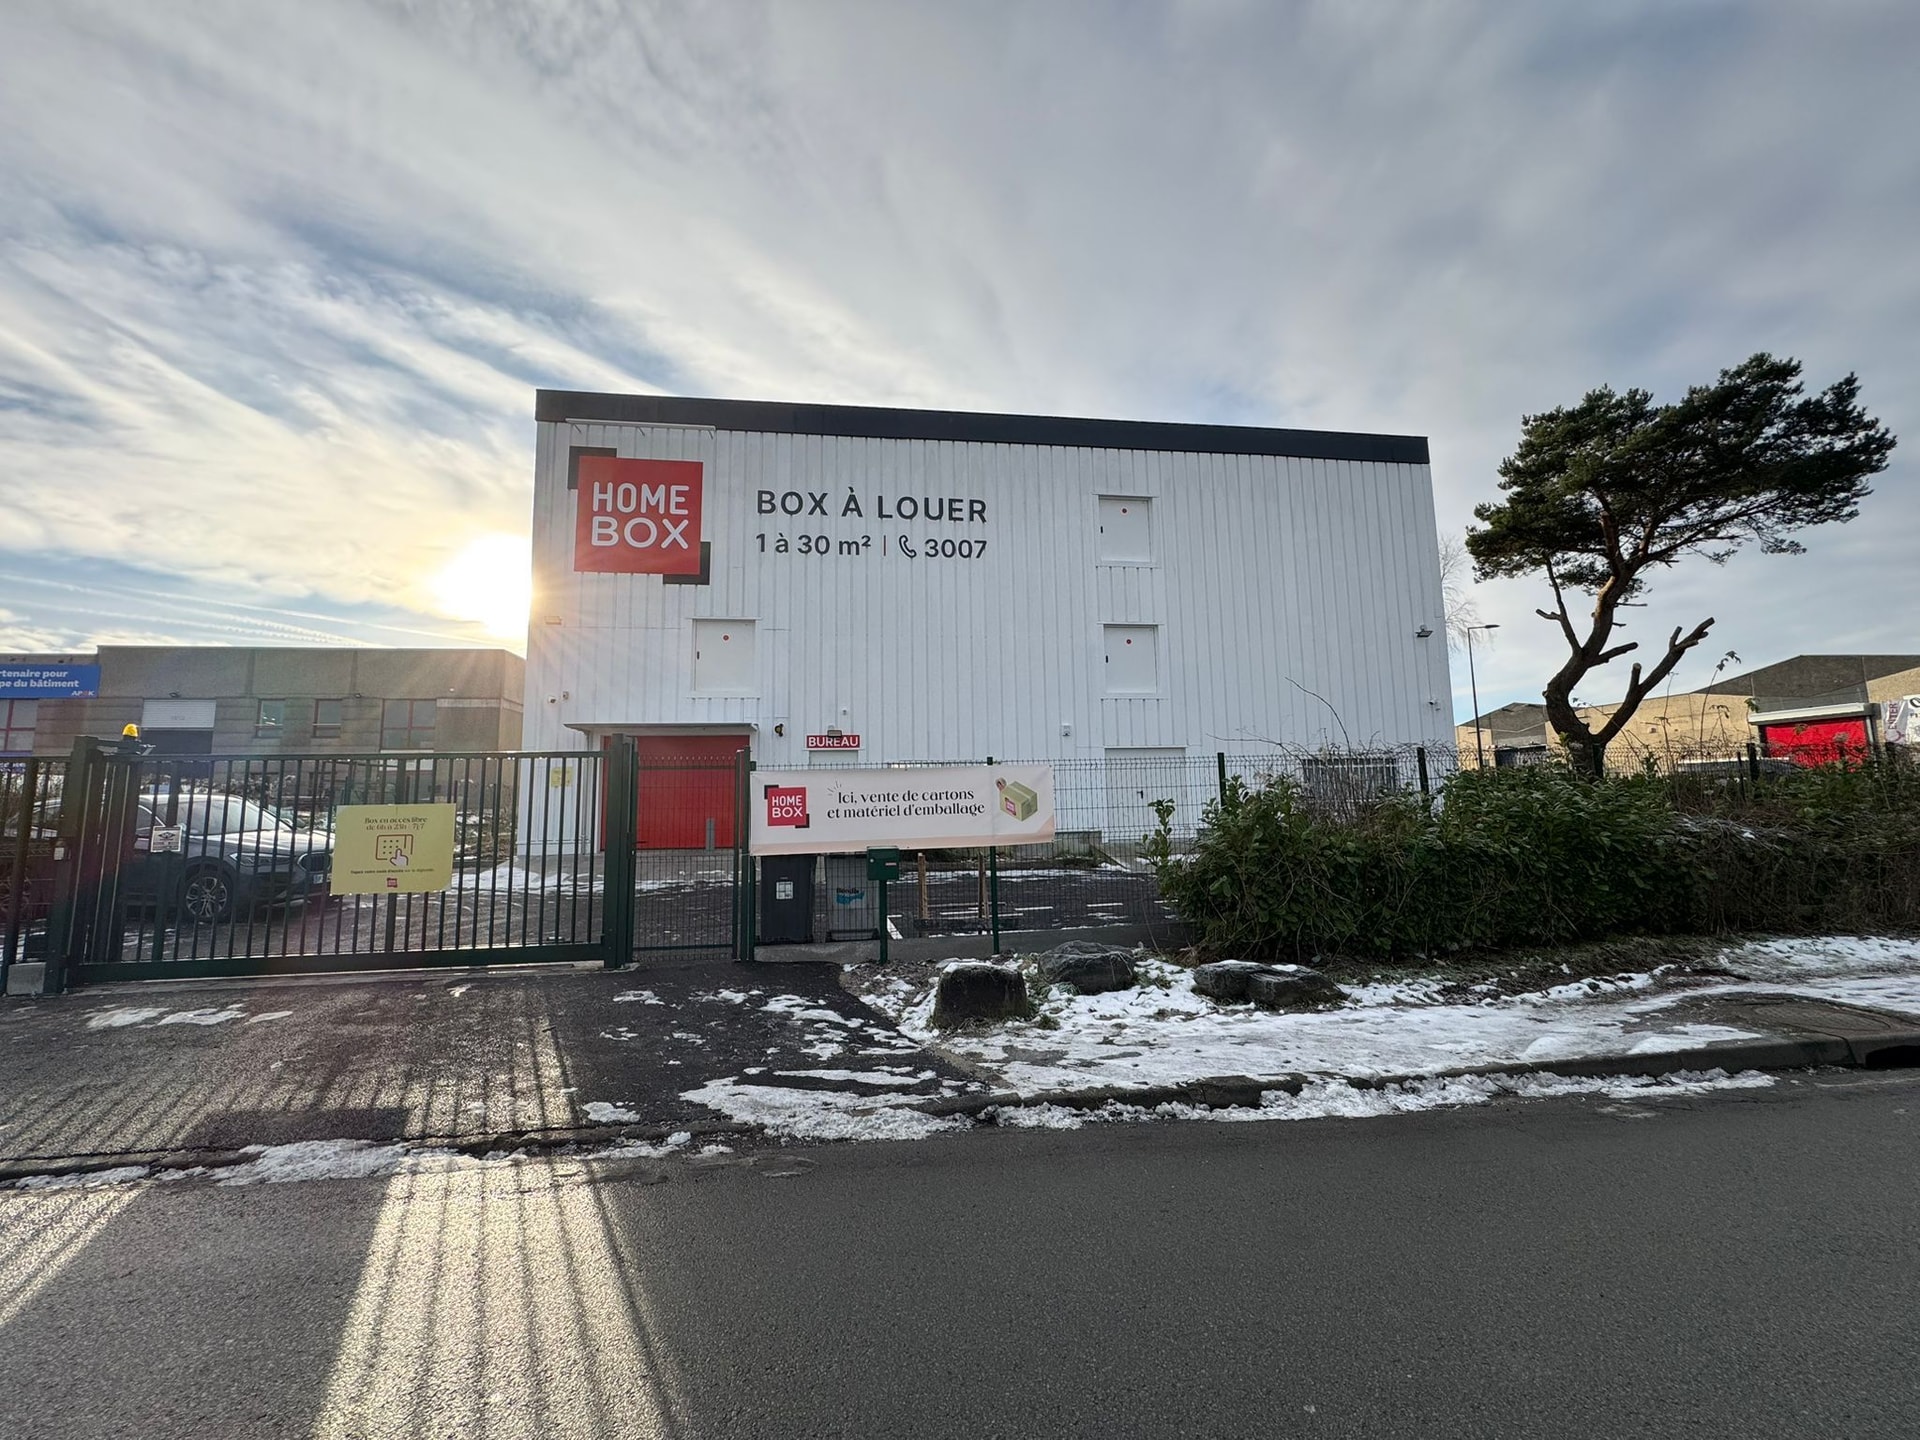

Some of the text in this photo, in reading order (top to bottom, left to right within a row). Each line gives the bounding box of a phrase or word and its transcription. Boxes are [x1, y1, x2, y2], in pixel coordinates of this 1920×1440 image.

[592, 482, 689, 515] HOME
[757, 486, 987, 523] BOX À LOUER
[591, 516, 689, 549] BOX
[756, 532, 987, 559] 1 à 30 m² 3007
[42, 671, 68, 679] pour
[14, 679, 28, 688] du
[30, 679, 80, 688] bâtiment
[808, 736, 858, 747] BUREAU
[772, 795, 802, 806] HOME
[838, 790, 975, 804] Ici, vente de cartons
[772, 807, 803, 818] BOX
[827, 803, 985, 819] et matériel d'emballage
